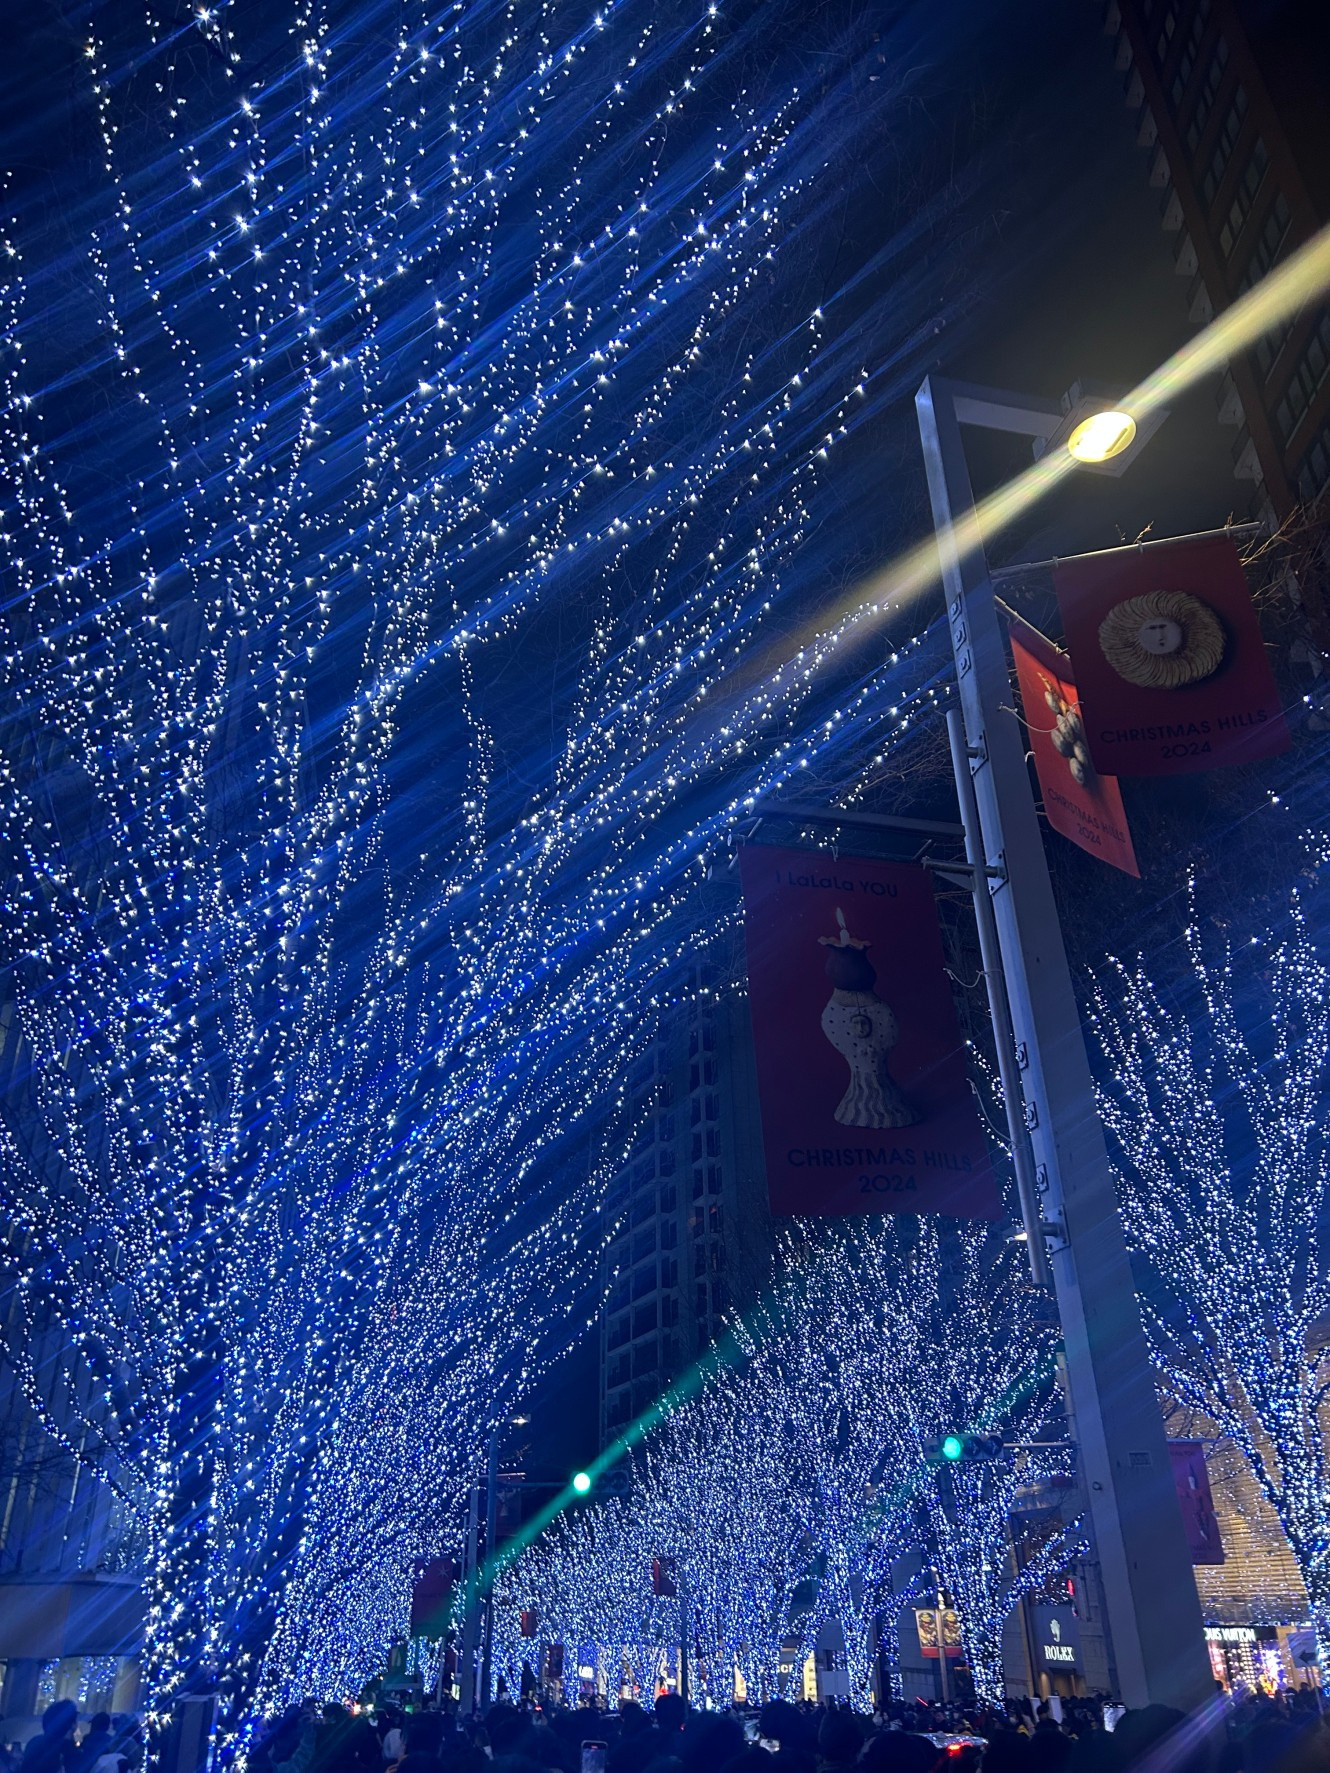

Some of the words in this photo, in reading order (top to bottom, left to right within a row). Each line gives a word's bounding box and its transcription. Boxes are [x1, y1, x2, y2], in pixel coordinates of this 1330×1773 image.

[1100, 720, 1212, 743] CHRISTMAS
[1218, 709, 1267, 730] HILLS
[1160, 741, 1212, 759] 2024
[1047, 788, 1099, 829] CHRISTMAS
[1101, 823, 1126, 843] HILLS
[1077, 824, 1102, 846] 2024
[789, 871, 854, 891] LaLaLa
[859, 880, 898, 897] YOU
[788, 1147, 916, 1168] CHRISTMAS
[924, 1152, 972, 1172] HILLS
[859, 1175, 917, 1193] 2024
[1203, 1627, 1222, 1641] OUIS
[1043, 1645, 1075, 1661] ROLEX
